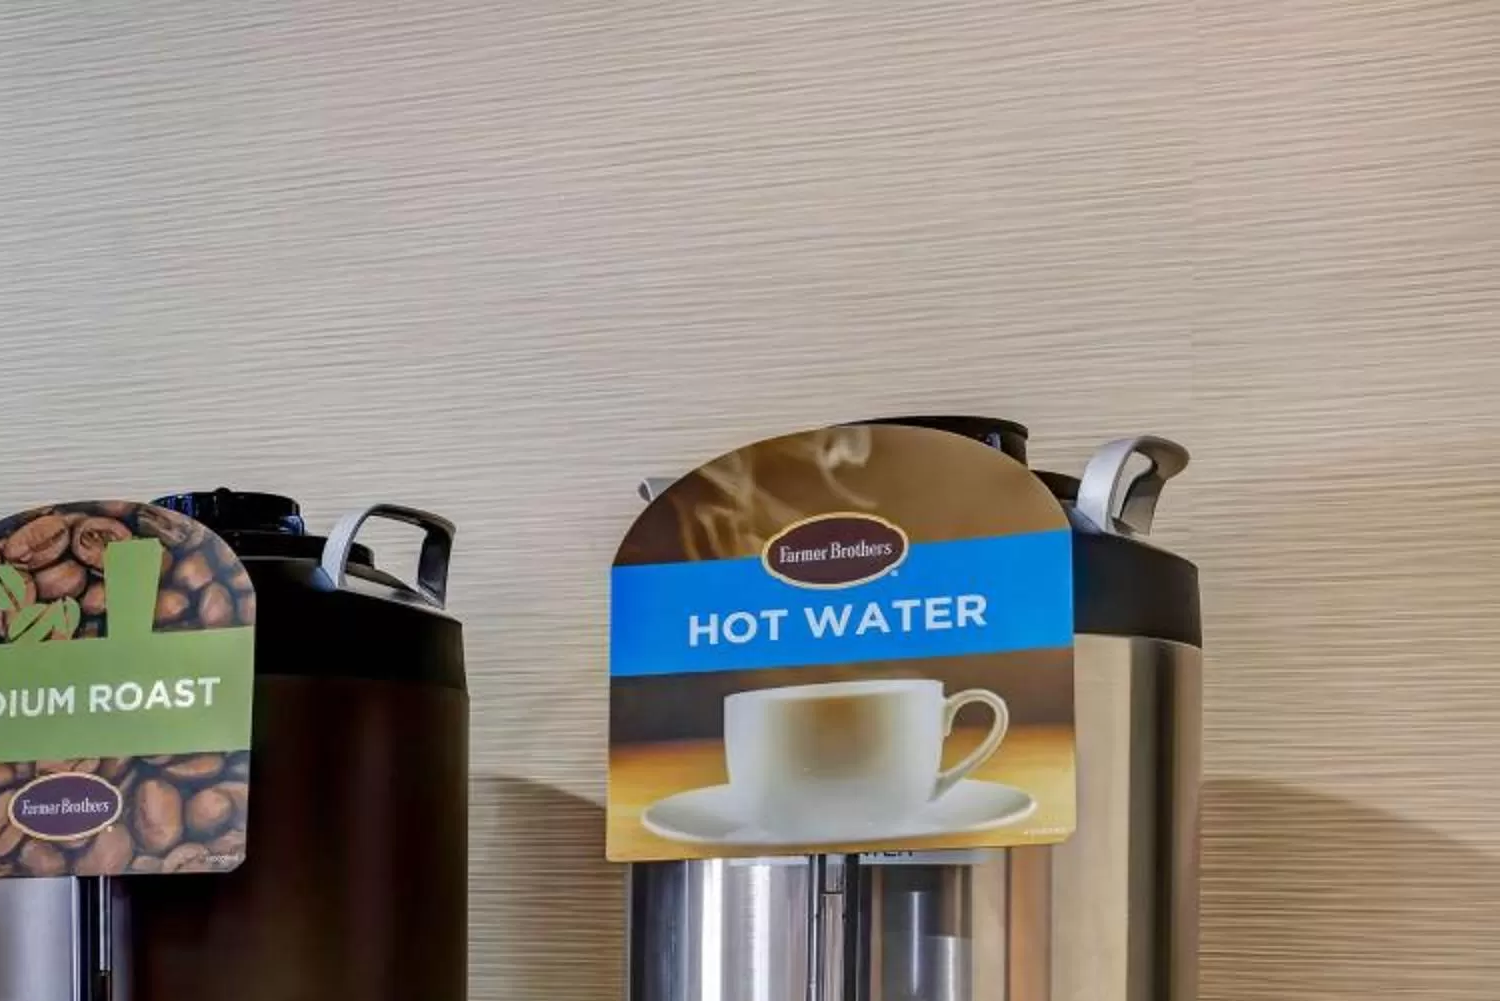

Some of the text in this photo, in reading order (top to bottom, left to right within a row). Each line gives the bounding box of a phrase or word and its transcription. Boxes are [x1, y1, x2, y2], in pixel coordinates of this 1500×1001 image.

[779, 540, 893, 563] Farmer Brothers
[688, 594, 988, 647] HOT WATER
[88, 677, 221, 714] ROAST
[21, 797, 110, 816] Farmer Brothers
